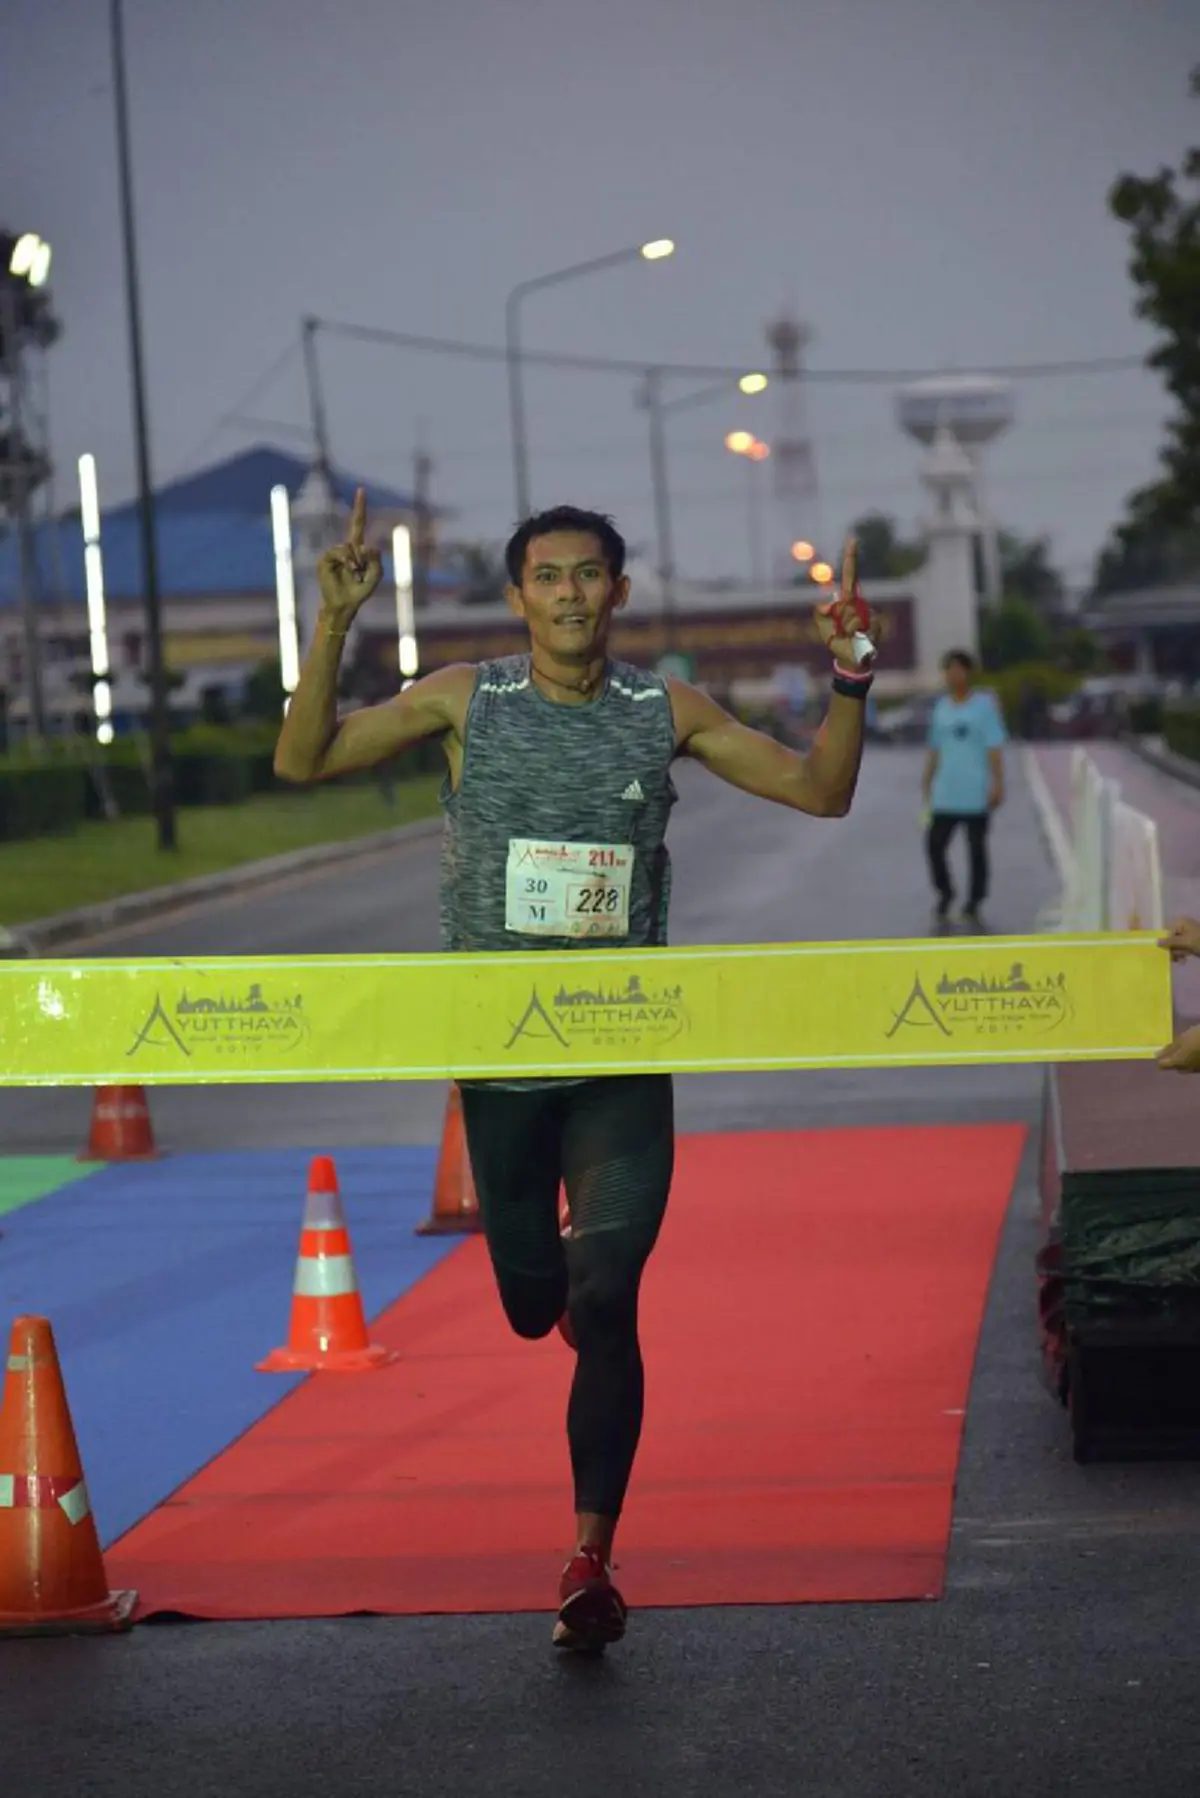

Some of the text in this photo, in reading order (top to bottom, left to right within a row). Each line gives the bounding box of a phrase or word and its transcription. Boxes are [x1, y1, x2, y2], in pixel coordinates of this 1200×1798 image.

[588, 849, 615, 867] 21.1
[525, 877, 548, 894] 30
[528, 905, 546, 921] M
[576, 888, 619, 914] 228
[504, 983, 677, 1049] AYUTTHAYA
[885, 971, 1060, 1038] AYUTTHAYA
[126, 993, 298, 1056] AYUTTHAYA
